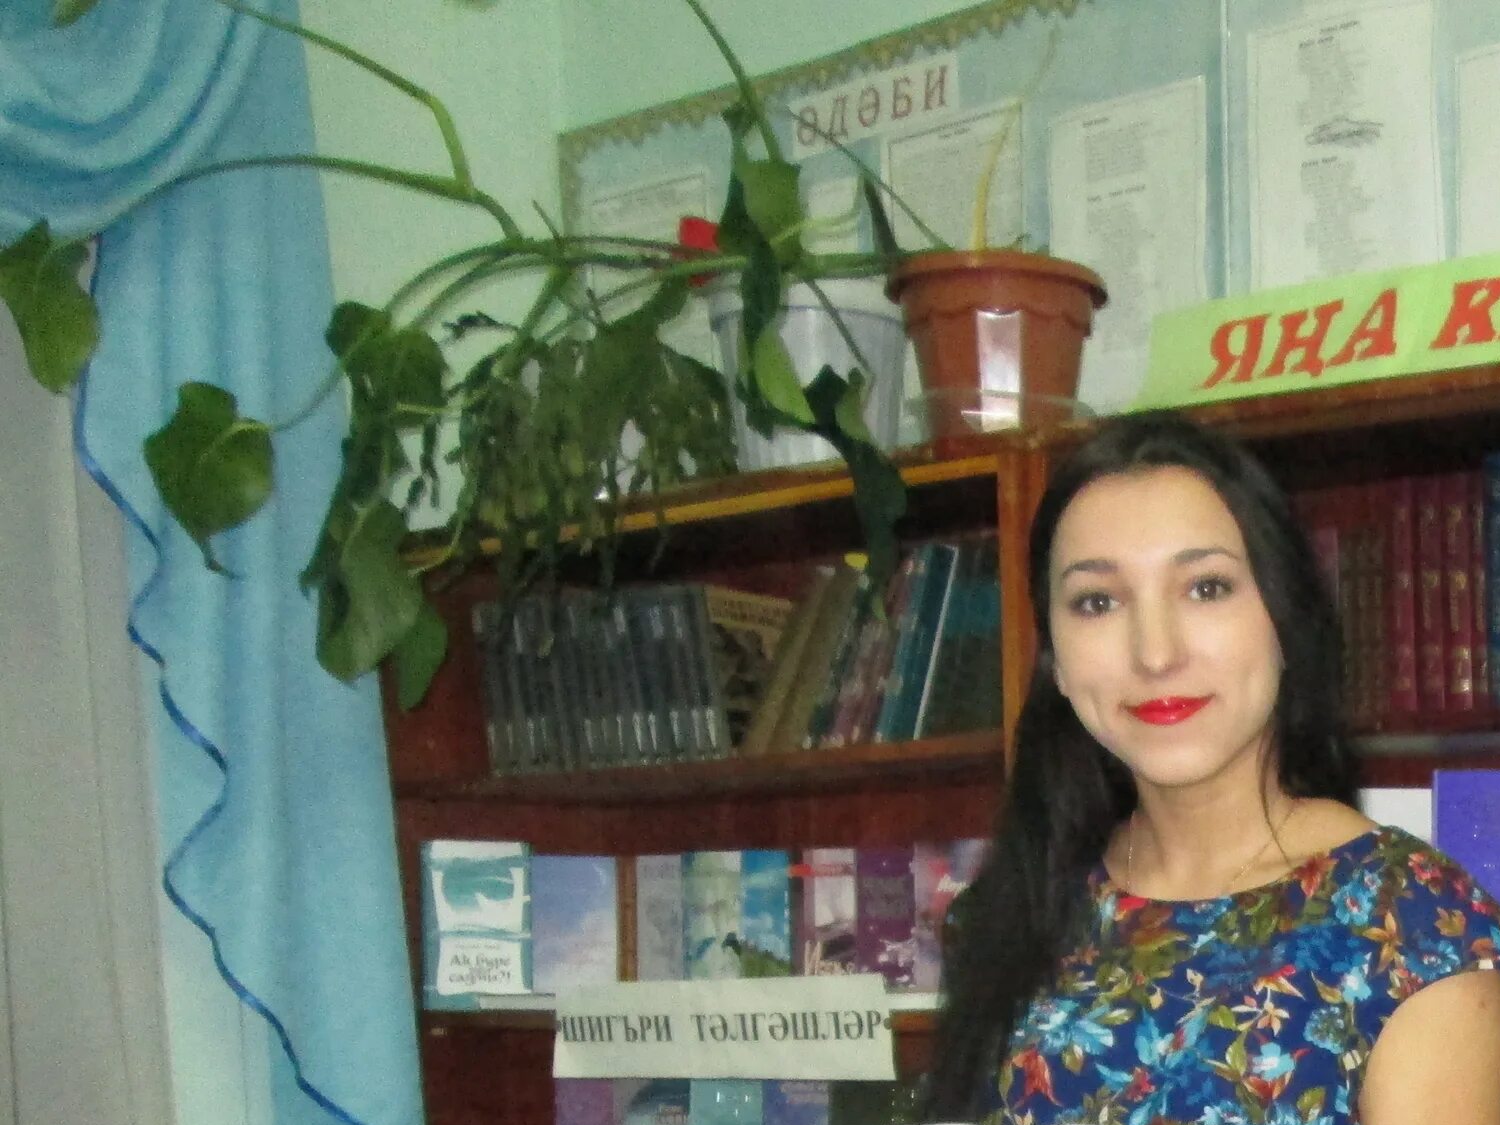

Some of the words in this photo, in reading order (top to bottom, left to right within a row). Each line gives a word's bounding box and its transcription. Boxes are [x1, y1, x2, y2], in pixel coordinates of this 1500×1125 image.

[1203, 288, 1398, 390] ЯҢА
[561, 1014, 672, 1043] ШИГЪРИ
[690, 1009, 882, 1043] ТӘЛГӘШЛӘР
